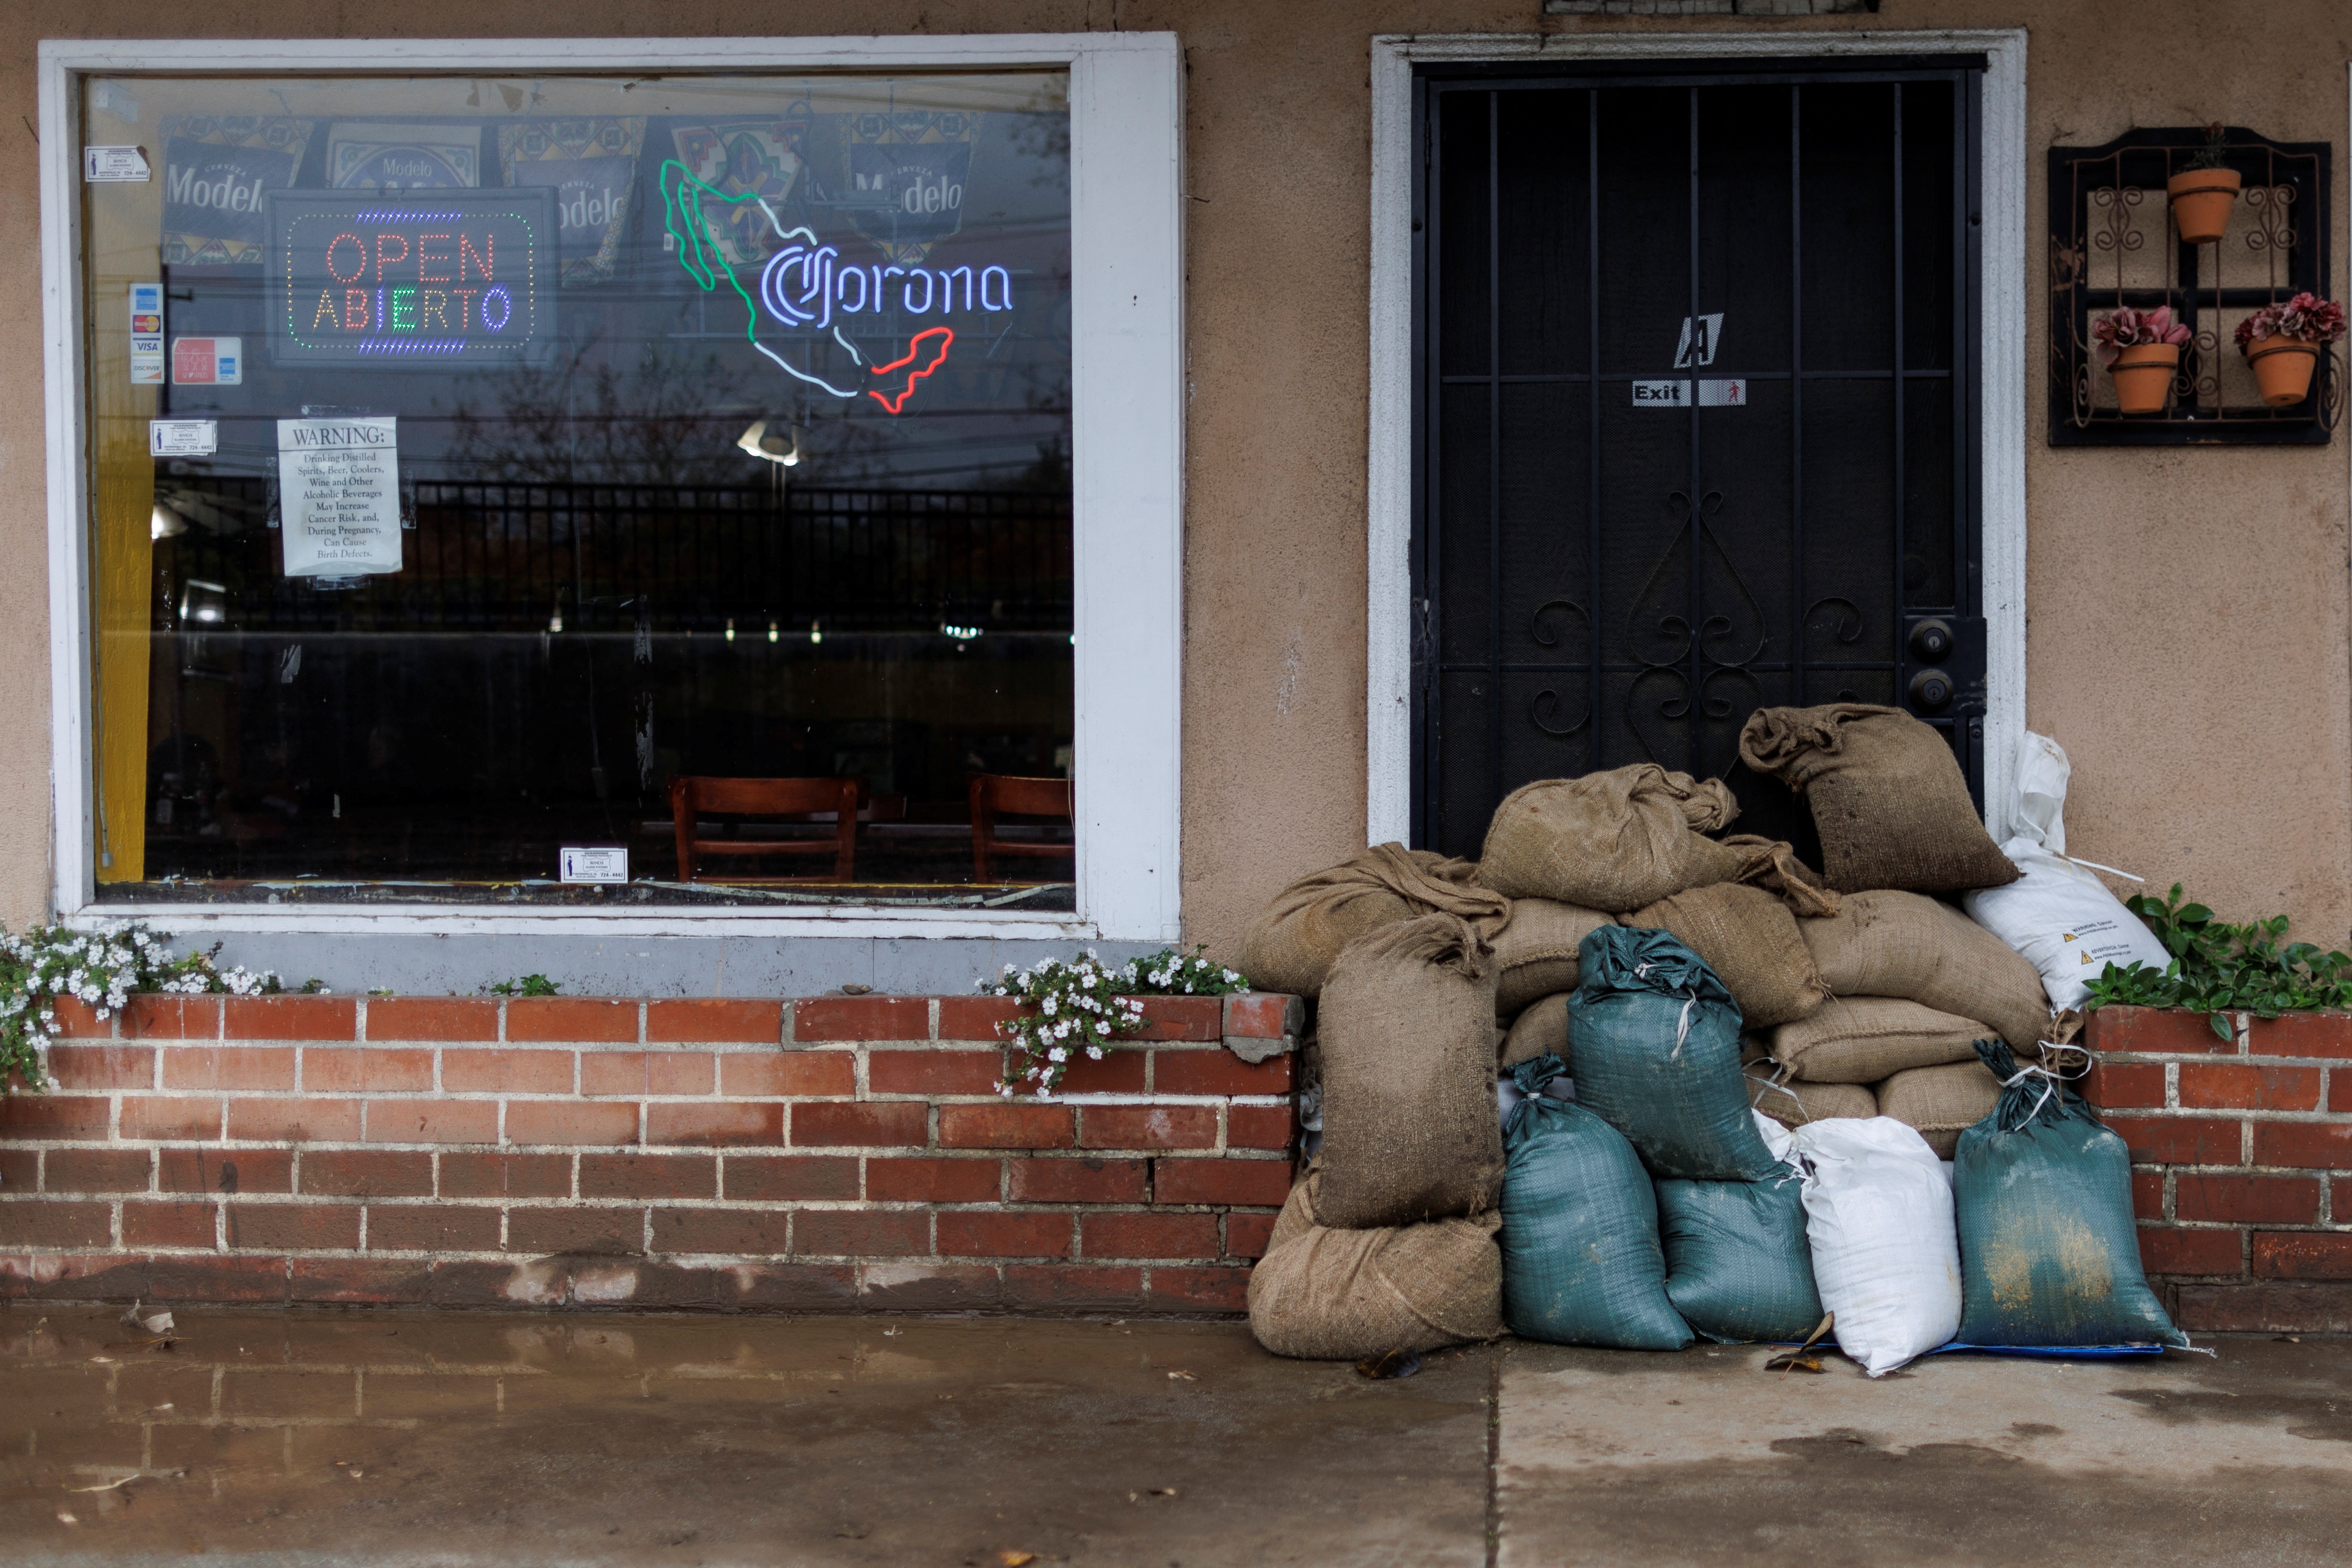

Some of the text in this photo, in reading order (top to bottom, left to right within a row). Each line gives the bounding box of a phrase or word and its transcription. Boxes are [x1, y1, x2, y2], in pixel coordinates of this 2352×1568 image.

[205, 164, 246, 177] CERVEZA
[383, 158, 432, 177] Modelo
[891, 165, 932, 177] ERVEZA
[559, 181, 595, 192] ERVEZA
[856, 173, 962, 213] Mdelo
[327, 234, 493, 282] OPEN
[762, 246, 1013, 328] Corona
[312, 287, 512, 331] ABIERTO
[1634, 385, 1680, 399] Exit
[293, 427, 385, 446] WARNING:
[304, 452, 376, 464] Drinking Distilled
[298, 465, 384, 477] Spirits, Beer, Coolers,
[309, 477, 373, 487] Wine and Other
[303, 490, 382, 499] Alcoholic Beverages
[316, 502, 333, 512] May
[308, 513, 379, 523] Cancer Risk, and,
[308, 526, 381, 536] During Pregnancy,
[343, 538, 366, 546] Cause
[317, 549, 373, 559] Birth Defects.
